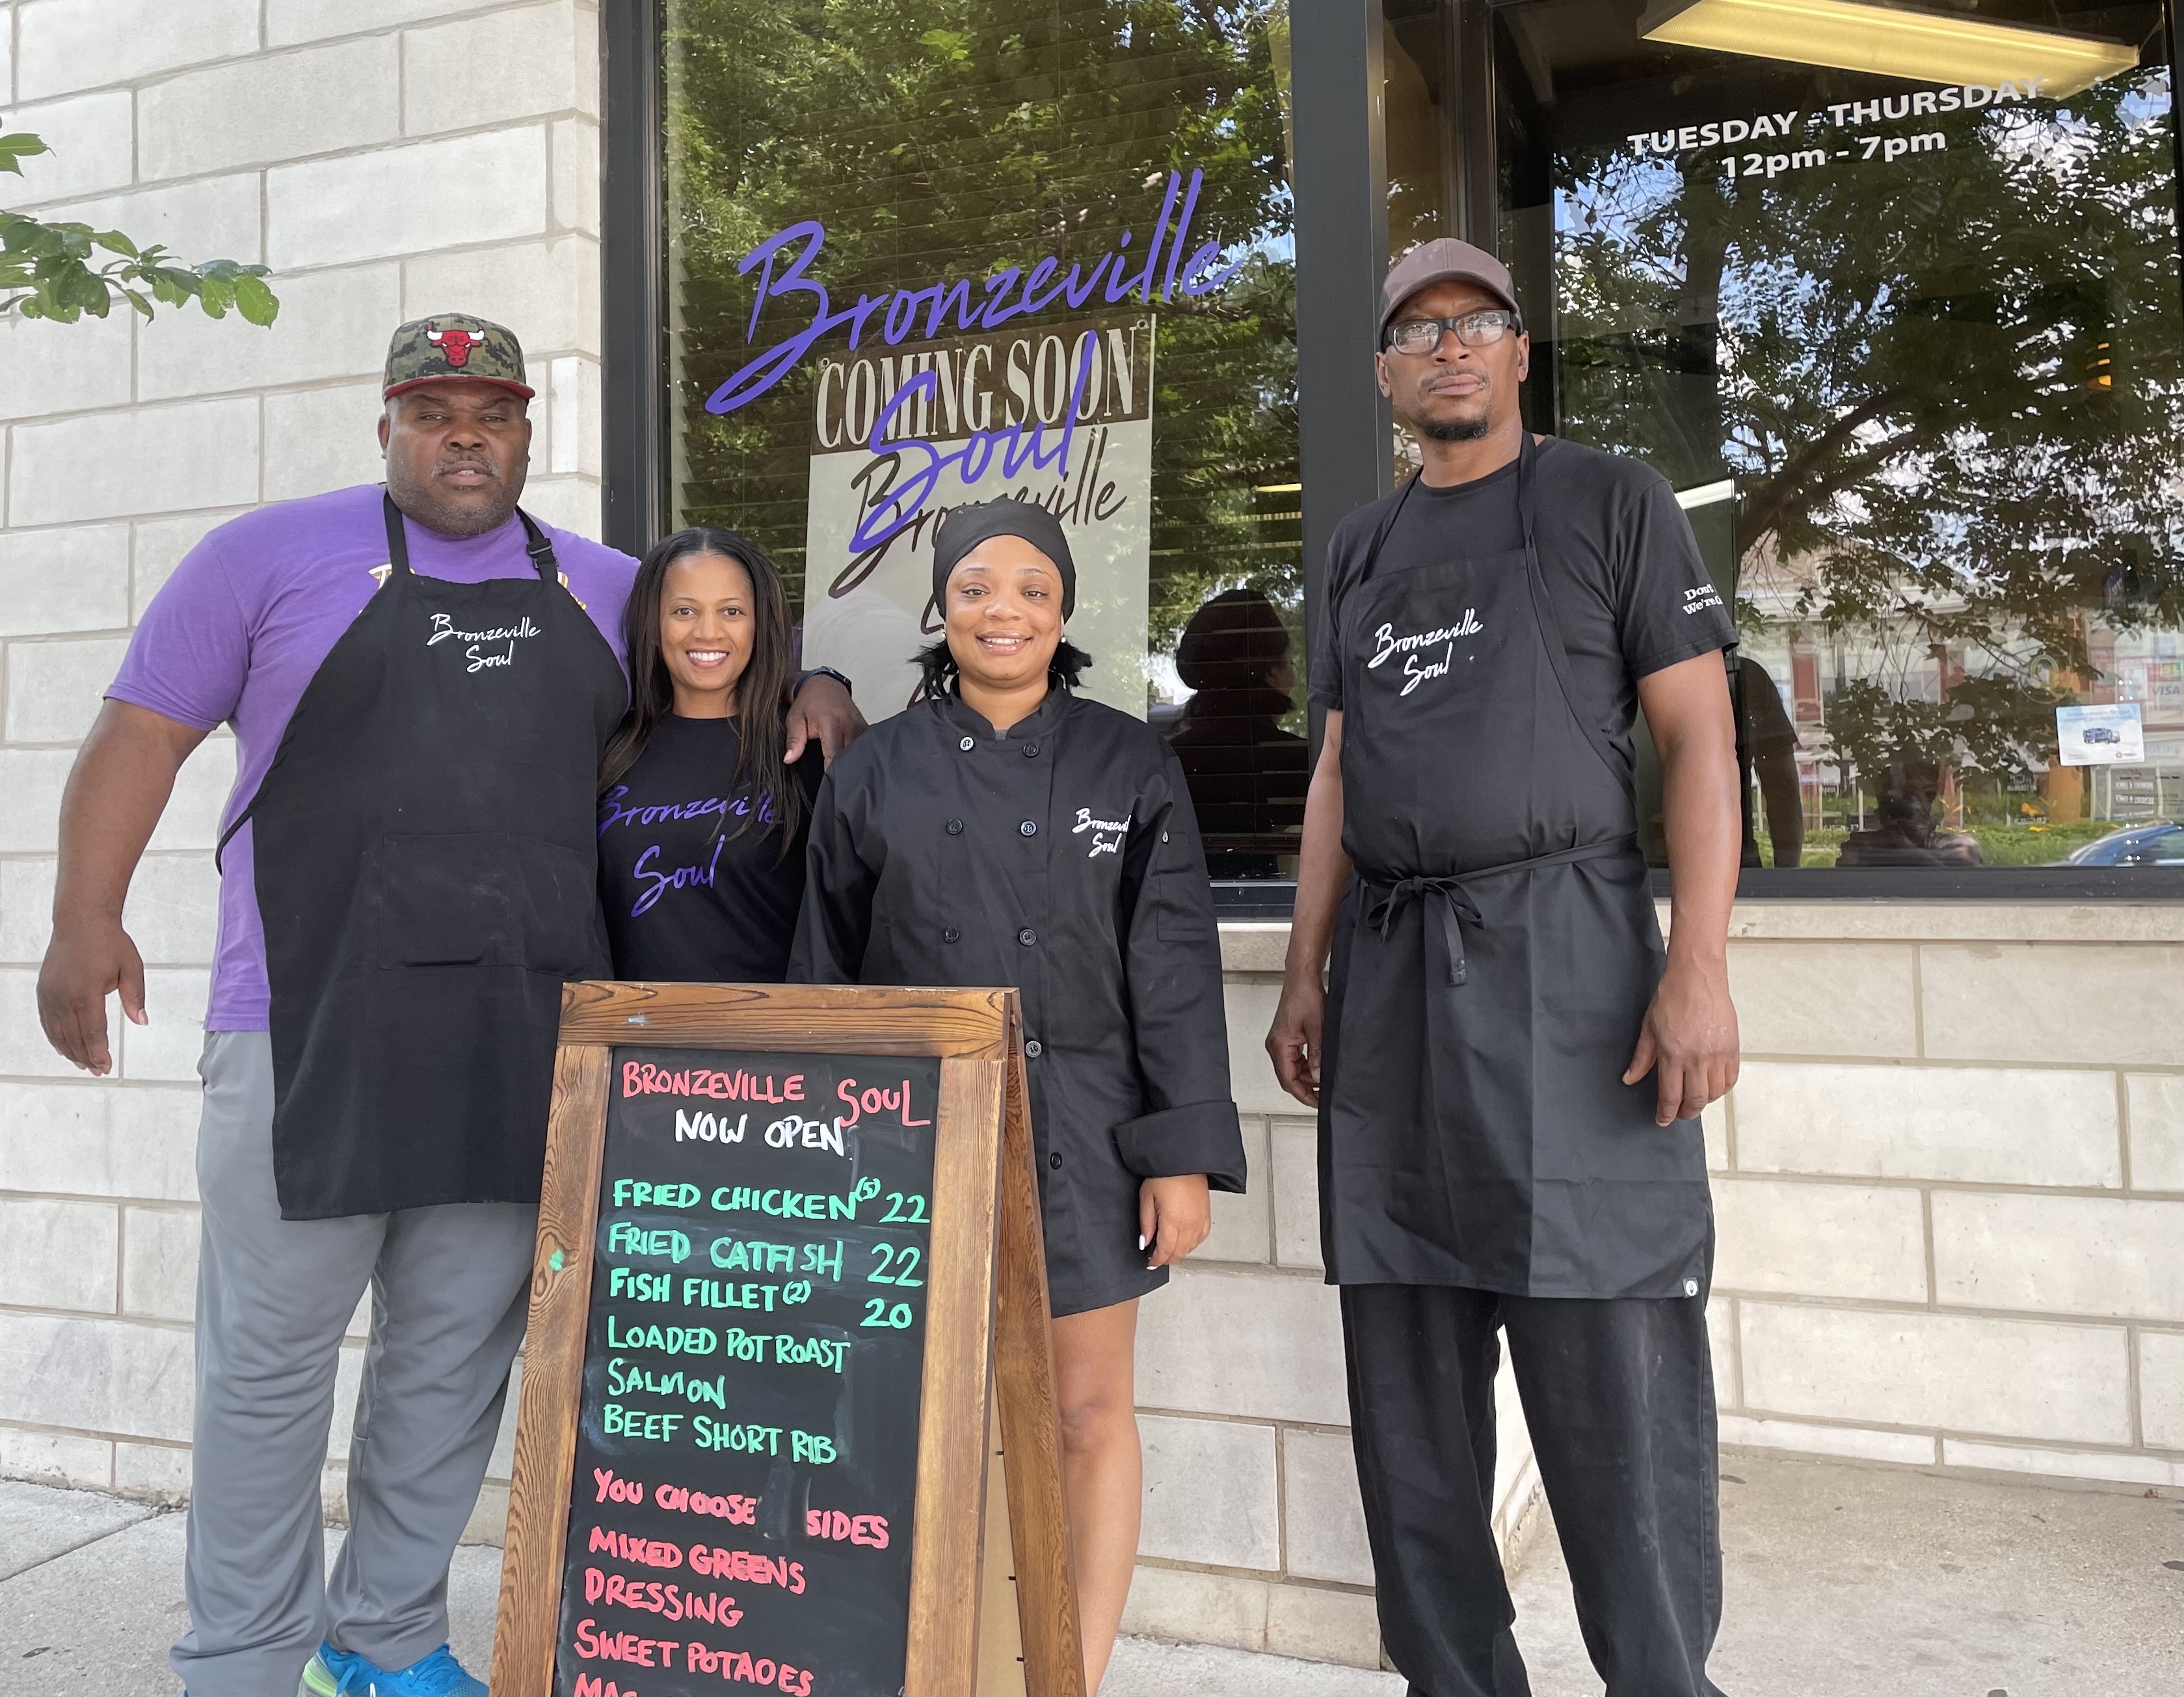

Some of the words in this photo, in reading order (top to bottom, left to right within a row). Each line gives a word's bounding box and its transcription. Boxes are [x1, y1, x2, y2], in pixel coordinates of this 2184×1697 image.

[1627, 110, 1799, 156] TUESDAY
[1827, 75, 2045, 127] THURSDAY
[1721, 147, 1826, 180] 12pm
[1859, 131, 1947, 163] 7pm
[705, 168, 1244, 415] Bronzeville
[816, 343, 994, 449] COMING
[1005, 327, 1138, 427] SOON
[849, 329, 1098, 554] Soul
[426, 613, 542, 647] Bronzeville
[465, 639, 514, 673] Soul
[1367, 608, 1484, 669] Bronzeville
[1399, 641, 1453, 696] Soul
[1072, 807, 1132, 834] Bronzevil
[1087, 832, 1123, 858] Soul
[630, 834, 725, 918] Soul
[622, 1061, 805, 1104] BRONZEVILLE
[837, 1078, 931, 1128] SOUL
[675, 1108, 748, 1144] NOW
[764, 1114, 845, 1156] OPEN
[613, 1179, 701, 1209] FRIED
[711, 1186, 856, 1220] CHICKEN
[879, 1192, 931, 1223] 22
[607, 1221, 691, 1264] FRIED
[867, 1242, 924, 1287] 22
[609, 1267, 671, 1302] FISH
[683, 1277, 779, 1312] FILLET
[860, 1298, 912, 1330] 20
[607, 1315, 717, 1354] LOADED
[726, 1328, 774, 1363] POT
[775, 1334, 851, 1374] ROAST
[607, 1357, 726, 1410] SALMON
[604, 1403, 684, 1443] BEEF
[693, 1415, 783, 1456] SHORT
[790, 1430, 837, 1464] RIB
[593, 1467, 643, 1504] YOU
[654, 1484, 757, 1525] CHOOSE
[806, 1510, 890, 1549] SIDES
[588, 1526, 683, 1569] MIXED
[687, 1543, 806, 1596] GREENS
[584, 1566, 744, 1627] DRESSING
[573, 1618, 680, 1668] SWEET
[686, 1642, 815, 1696] POTAOES
[573, 1672, 638, 1697] MA
